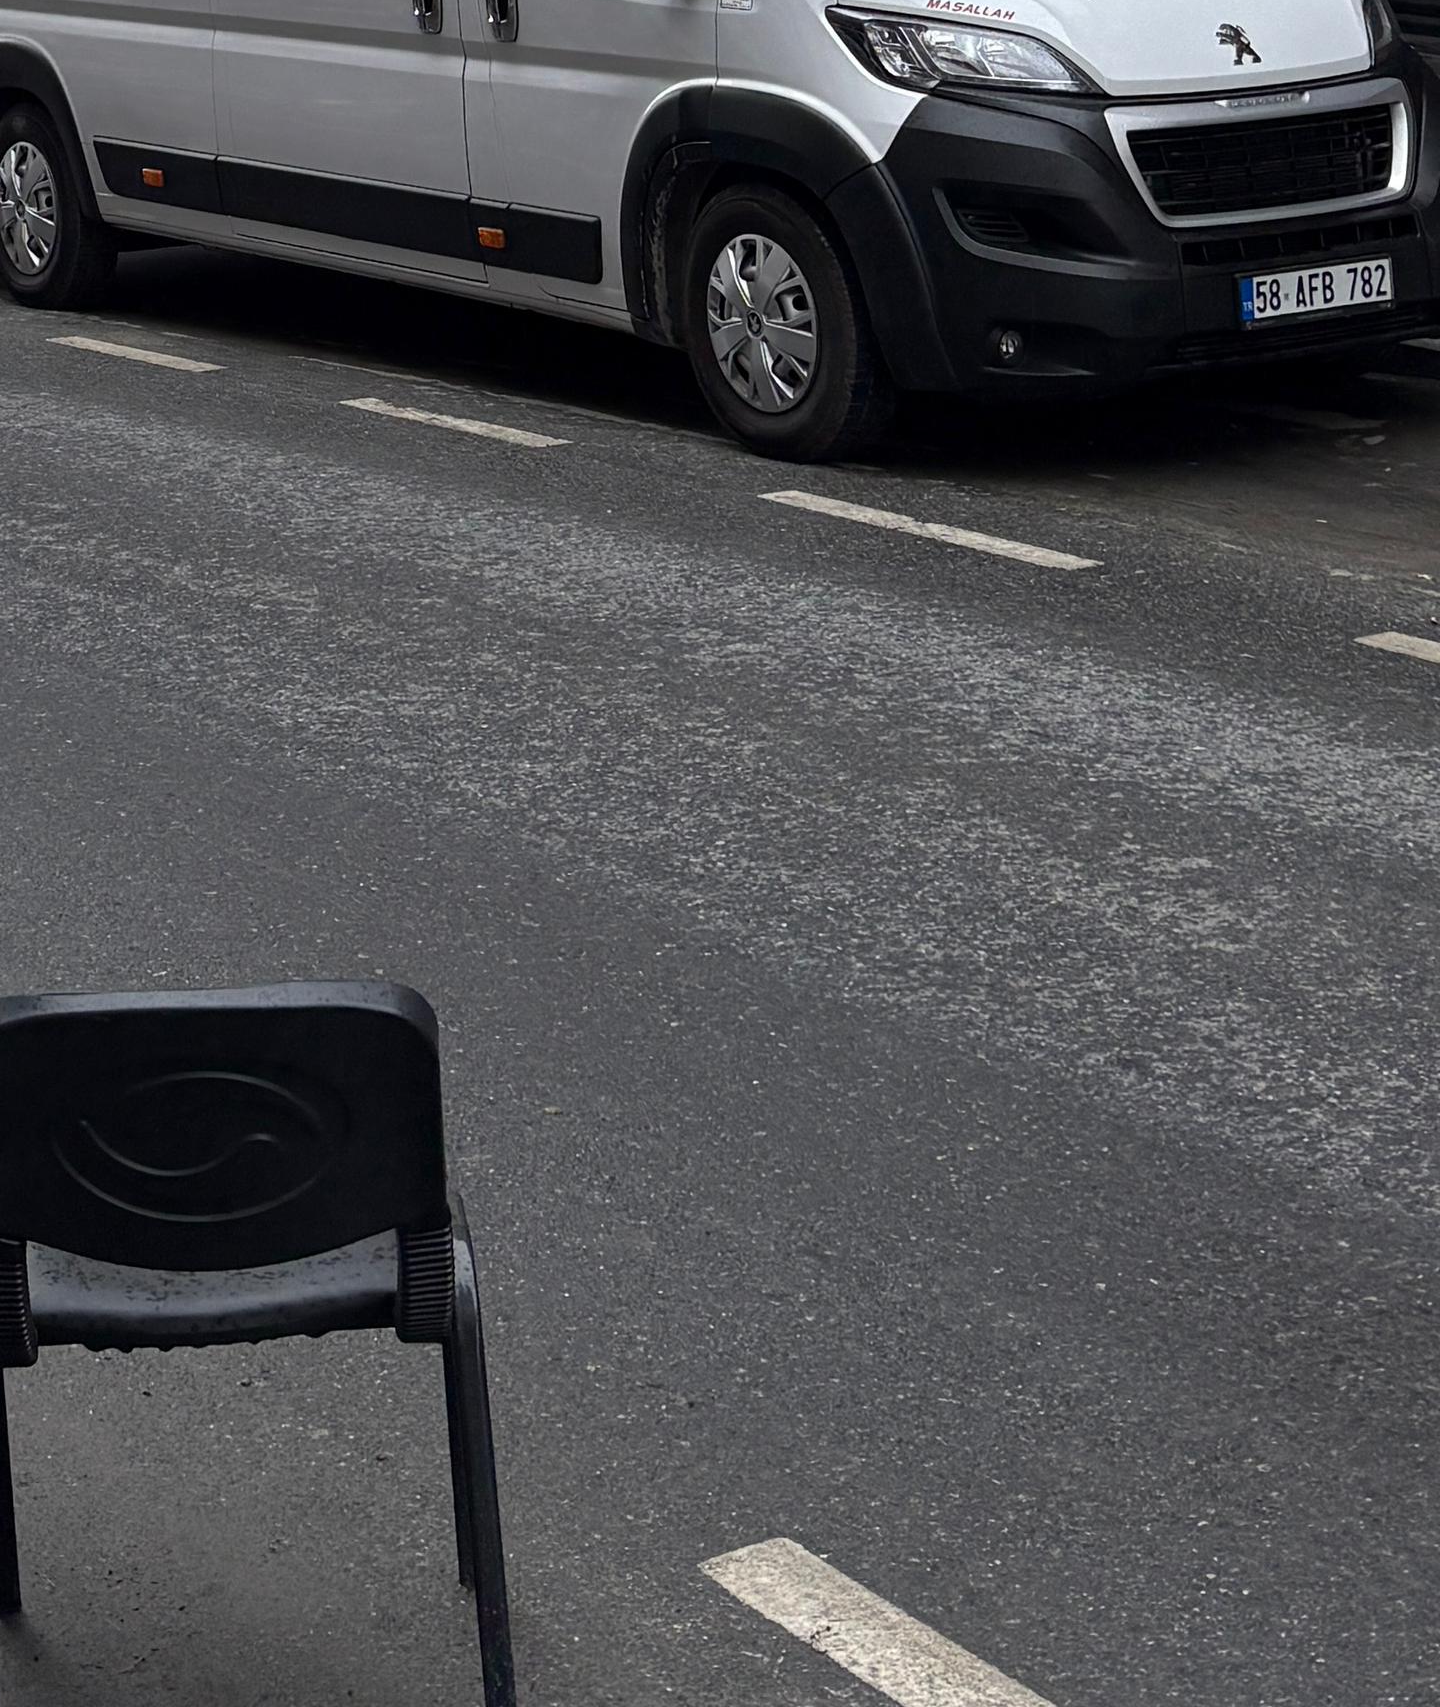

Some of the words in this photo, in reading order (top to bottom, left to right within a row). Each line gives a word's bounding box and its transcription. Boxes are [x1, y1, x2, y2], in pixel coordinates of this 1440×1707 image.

[1255, 278, 1281, 313] 58
[1296, 271, 1335, 308] AFB
[1346, 264, 1387, 301] 782
